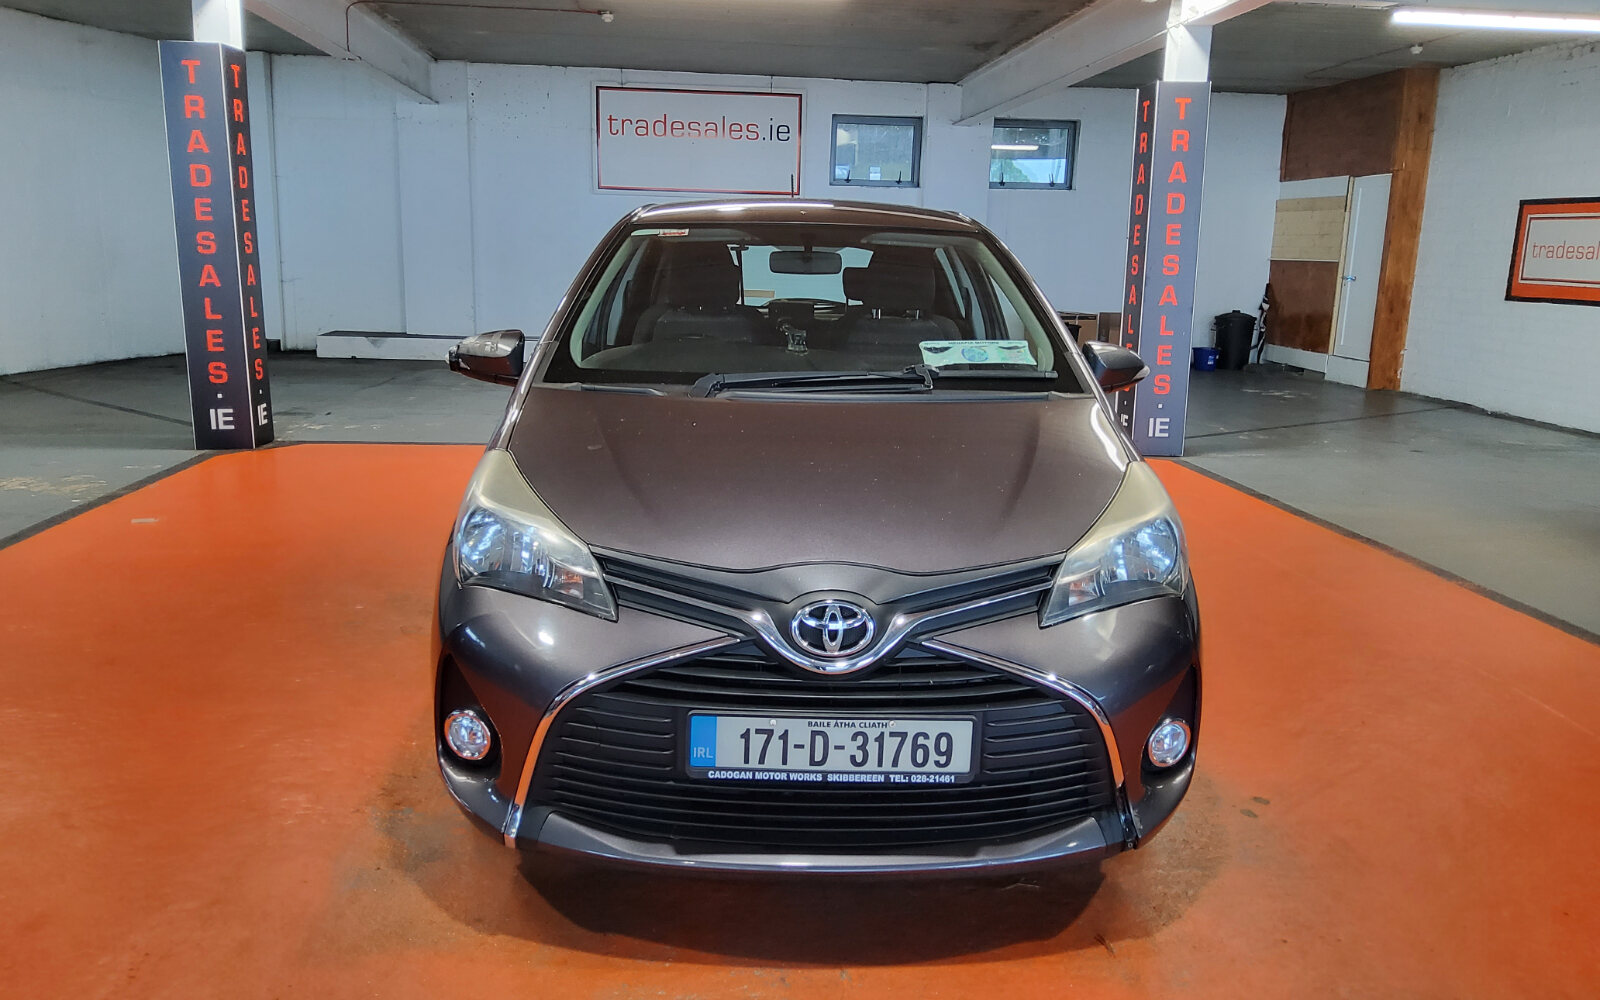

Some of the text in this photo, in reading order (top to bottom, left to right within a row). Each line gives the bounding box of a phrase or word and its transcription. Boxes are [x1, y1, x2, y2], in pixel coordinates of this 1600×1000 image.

[607, 113, 791, 142] tradesales.ie
[858, 721, 888, 729] CLIATH
[693, 746, 714, 759] IRL
[739, 727, 954, 768] 171-D-31769
[708, 770, 753, 780] CADOGAN
[755, 771, 788, 780] MOTOR
[789, 772, 823, 781] WORKS
[827, 773, 885, 783] SKIBBEREEN
[889, 774, 909, 783] TEL:
